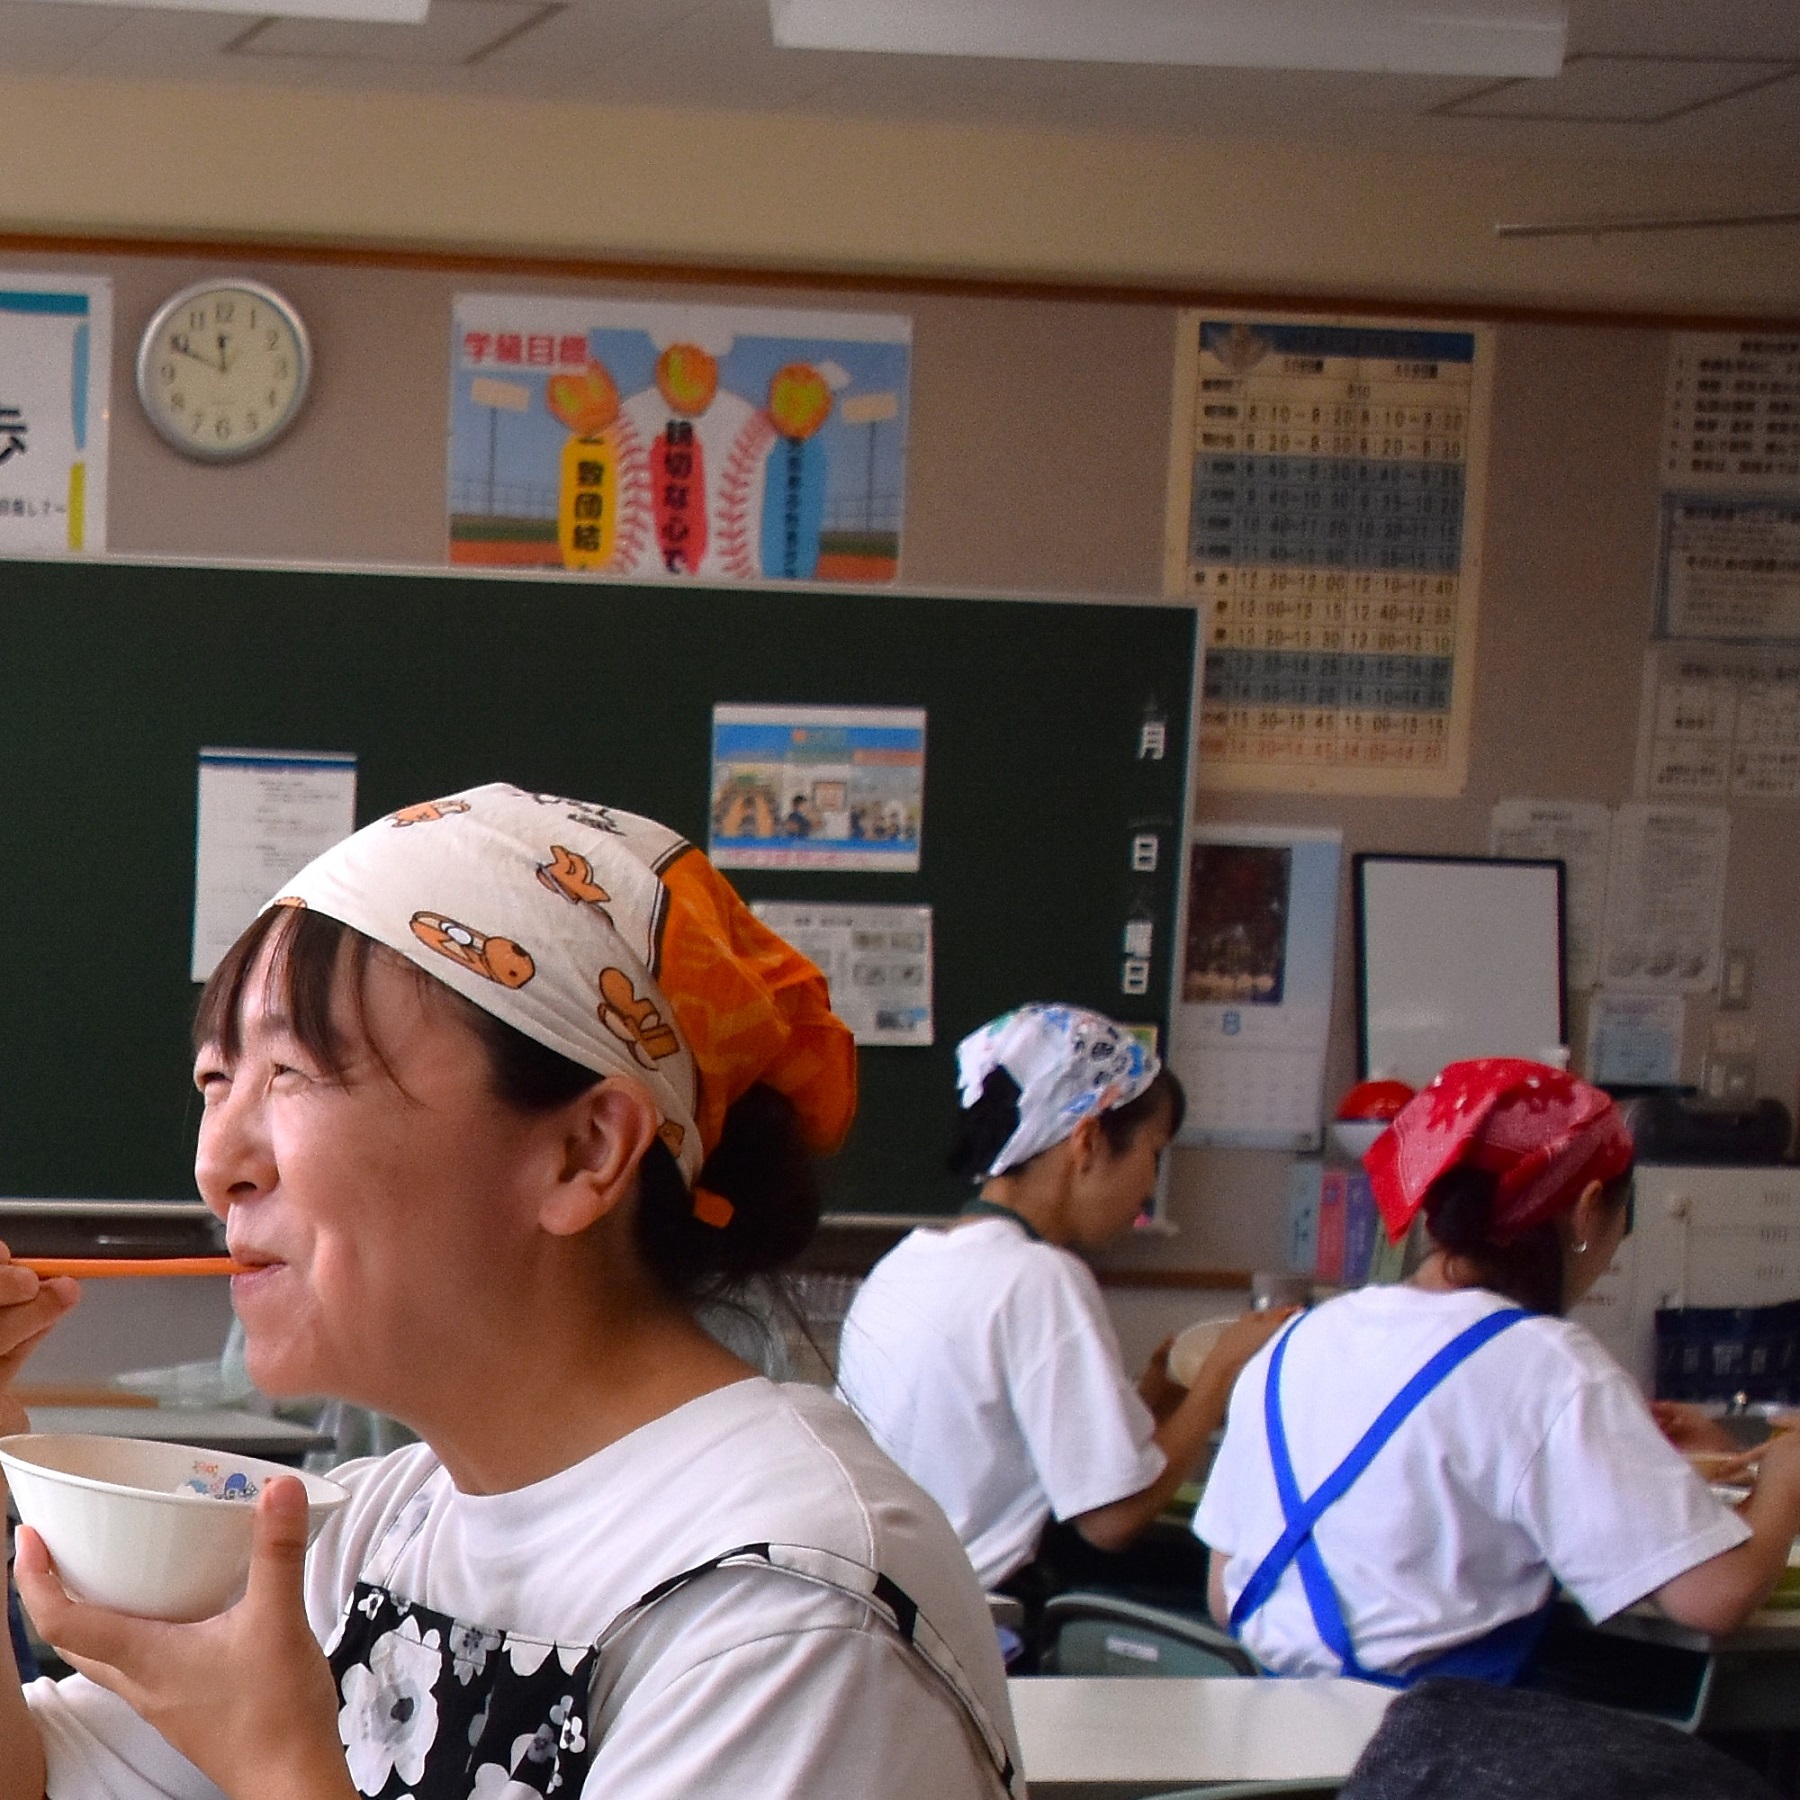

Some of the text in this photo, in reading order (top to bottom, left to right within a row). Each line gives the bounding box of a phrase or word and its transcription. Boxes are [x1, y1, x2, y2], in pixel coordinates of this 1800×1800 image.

[465, 332, 587, 365] 学級目標
[1140, 721, 1165, 759] 月
[1132, 834, 1158, 872] 日
